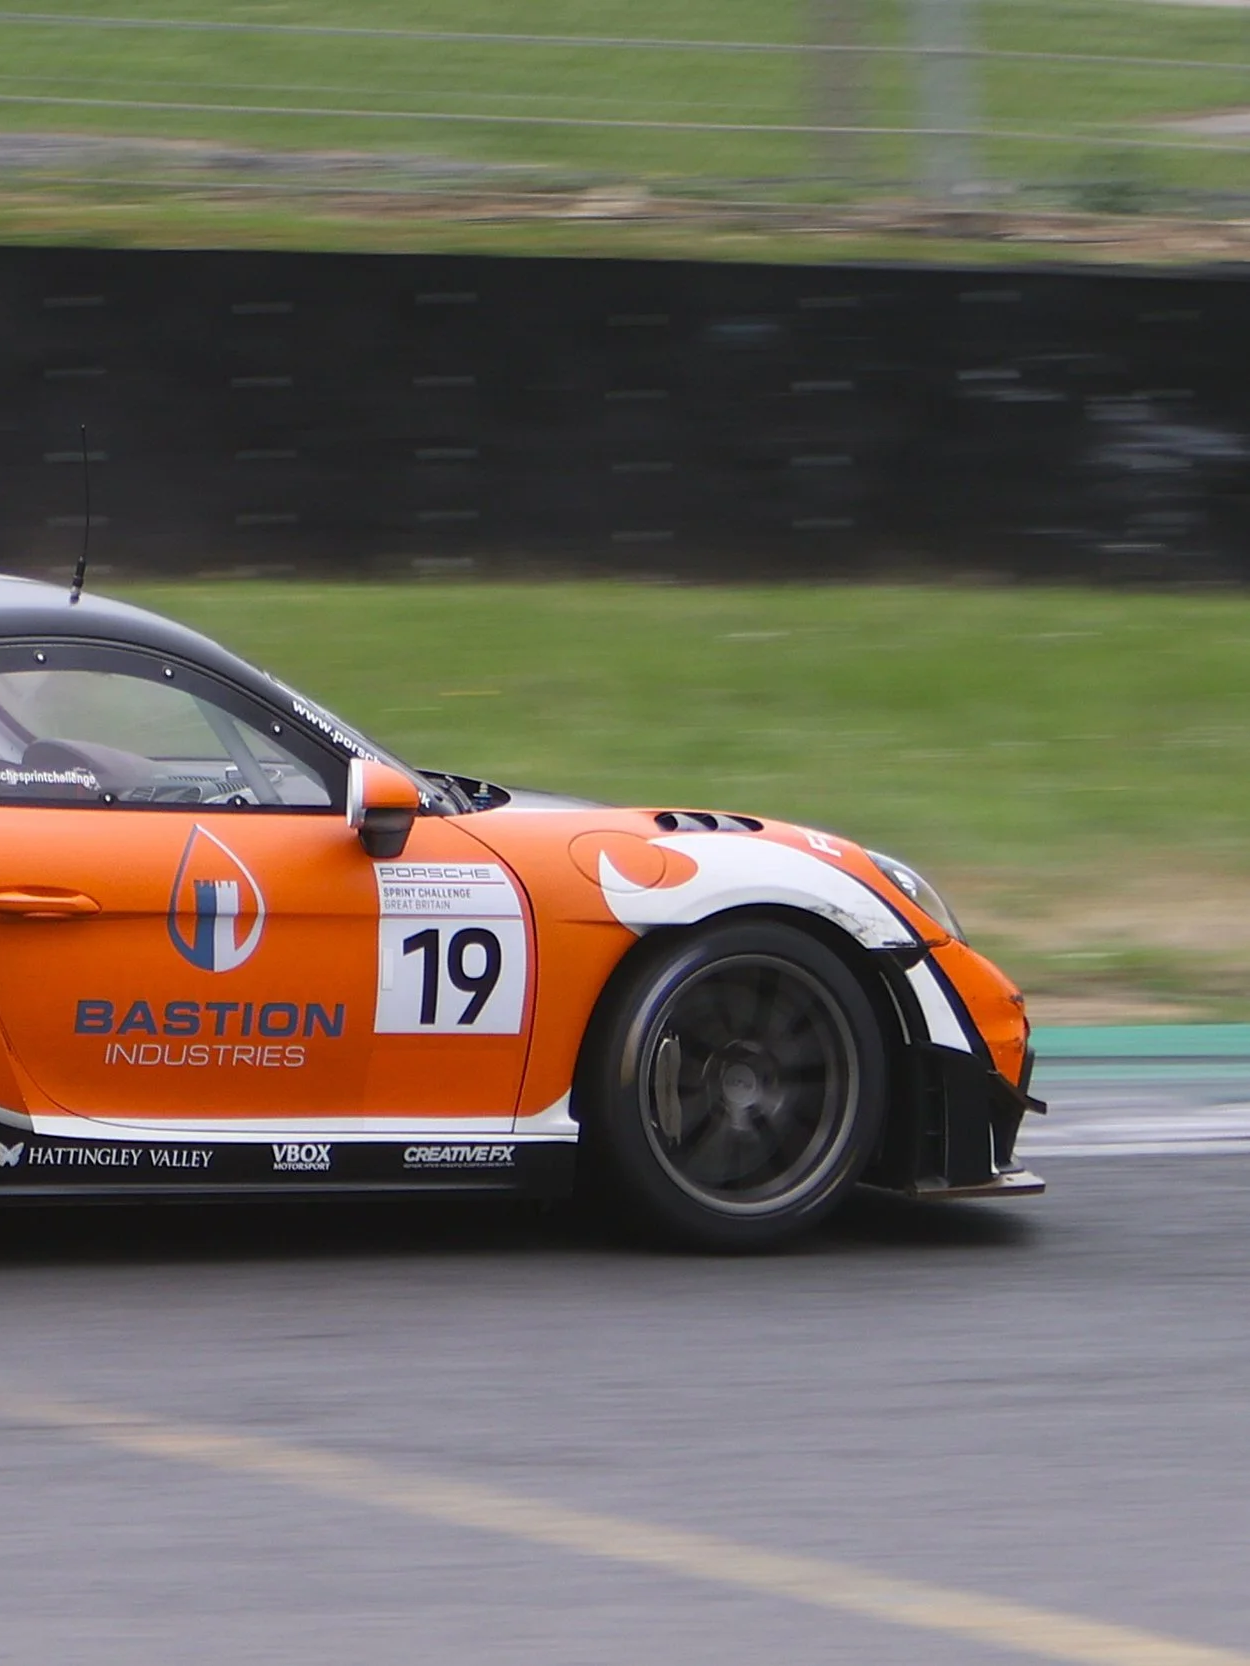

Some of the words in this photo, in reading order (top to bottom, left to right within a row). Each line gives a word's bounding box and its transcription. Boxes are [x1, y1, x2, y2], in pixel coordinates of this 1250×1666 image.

[379, 868, 491, 879] PORSCHE
[383, 888, 416, 898] SPRINT
[418, 888, 471, 898] CHALLENGE
[385, 900, 413, 910] GREAT
[416, 900, 451, 910] BRITAIN
[403, 927, 501, 1025] 19
[74, 998, 346, 1037] BASTION
[104, 1043, 306, 1067] INDUSTRIES
[28, 1147, 142, 1166] HATTINGLEY
[150, 1149, 213, 1168] VALLEY
[272, 1144, 331, 1162] VBOX
[273, 1161, 331, 1171] MOTORSPORT
